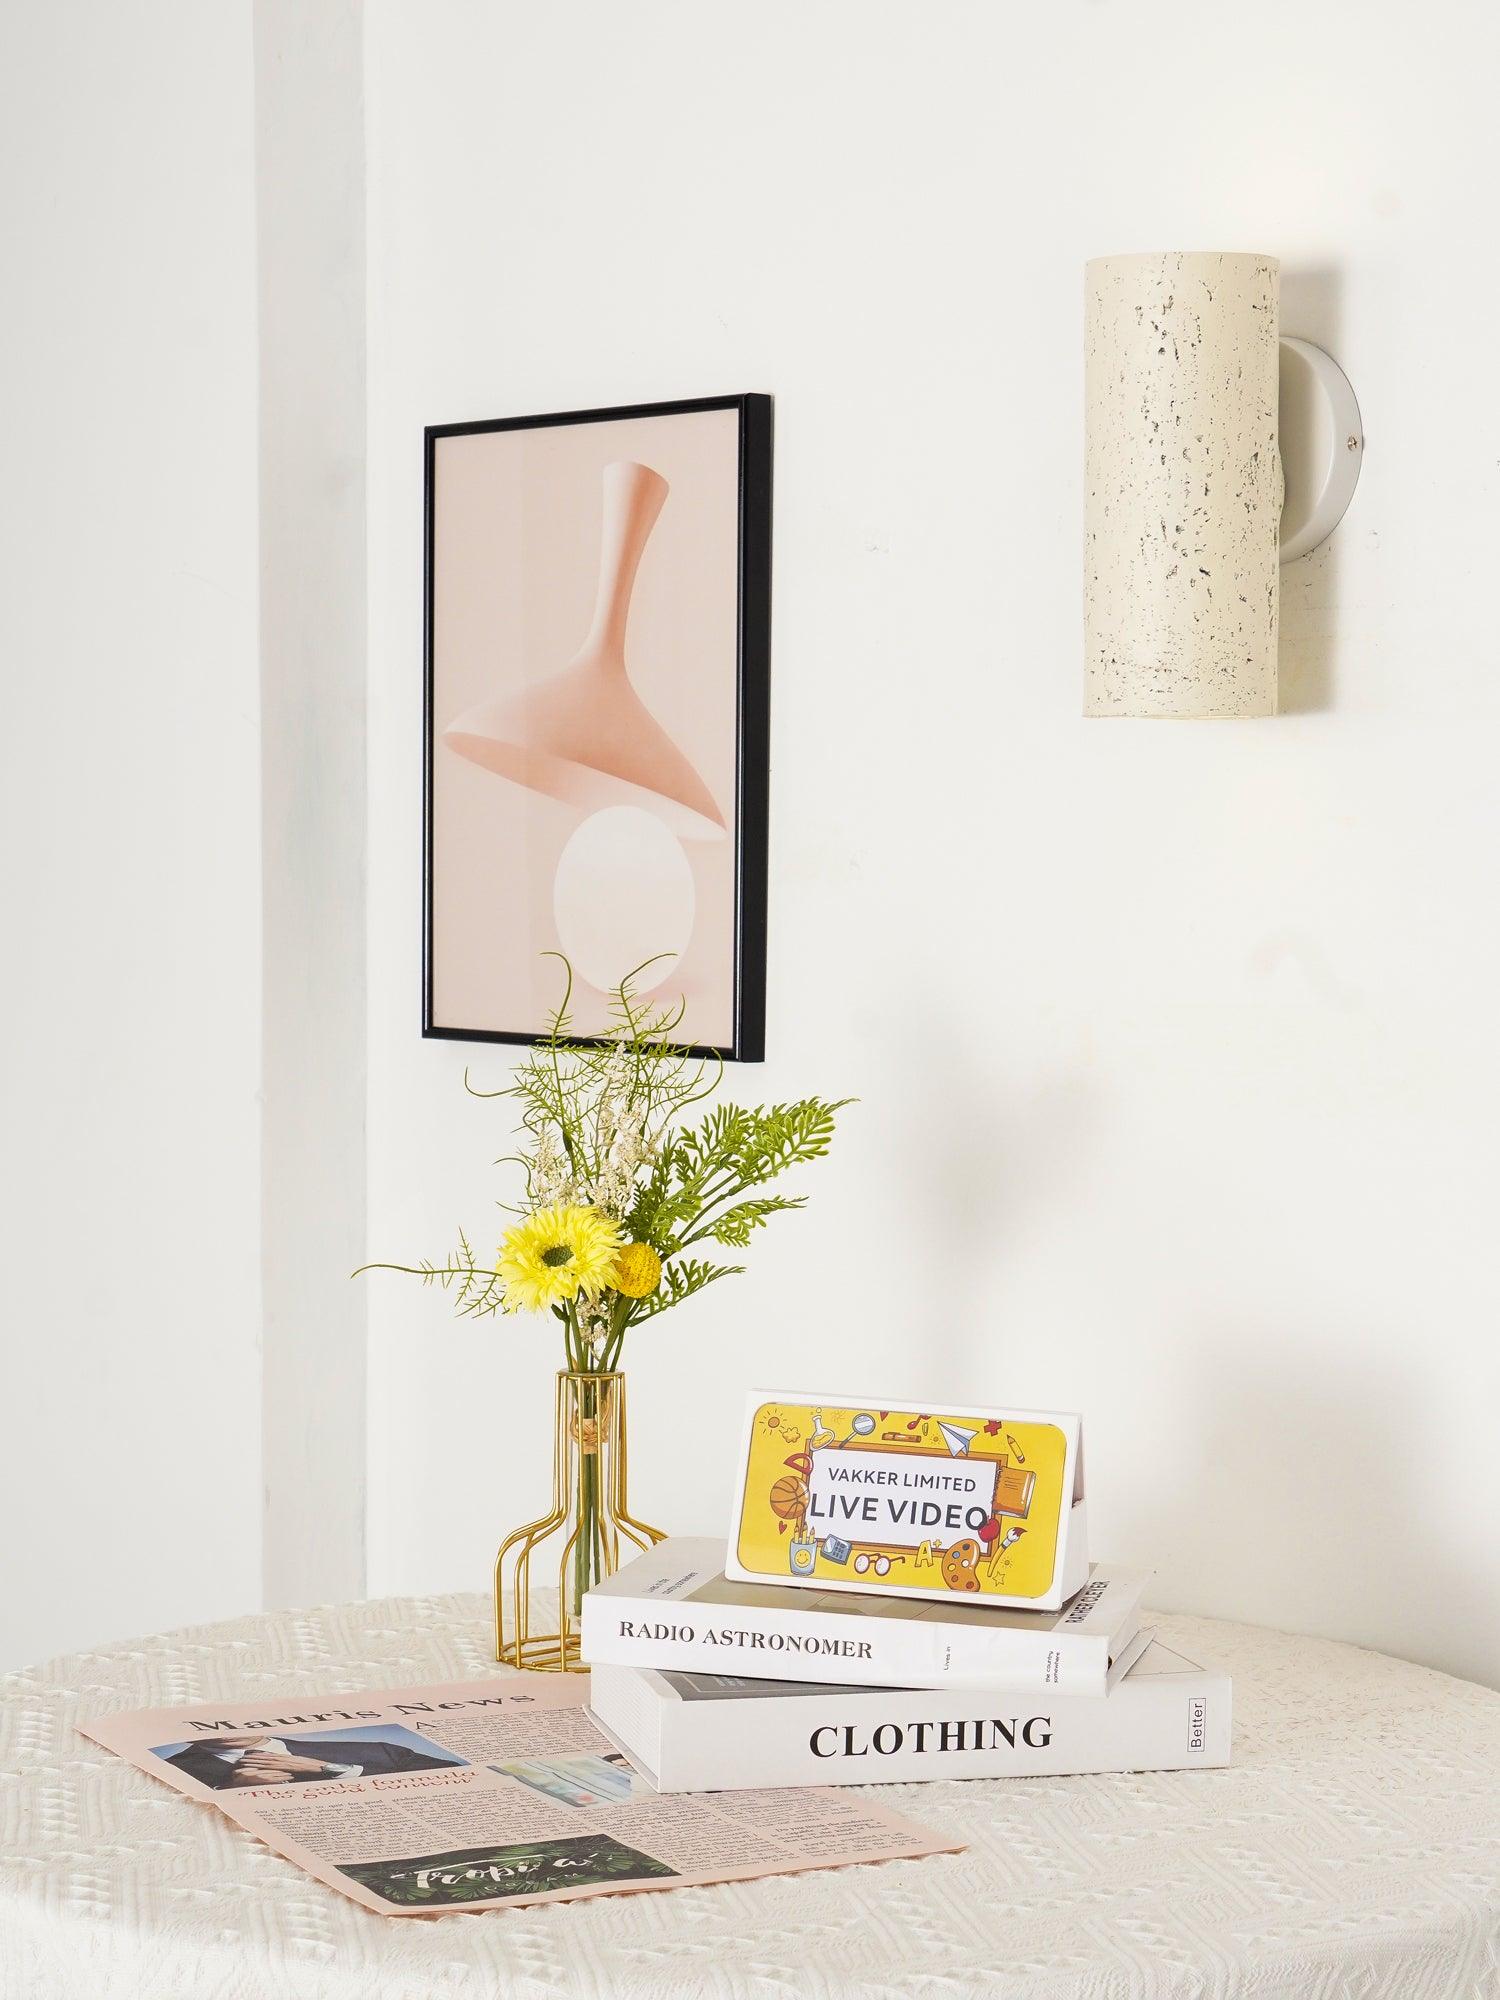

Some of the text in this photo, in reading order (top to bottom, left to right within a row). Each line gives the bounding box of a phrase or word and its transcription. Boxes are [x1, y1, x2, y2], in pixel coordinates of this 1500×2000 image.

[828, 1467, 976, 1492] VAKKER LIMITED
[810, 1493, 988, 1531] LIVE VIDEO
[619, 1620, 873, 1659] RADIO ASTRONOMER
[943, 1653, 951, 1671] Lives
[1046, 1650, 1054, 1673] country
[1053, 1651, 1061, 1683] somewhere
[184, 1695, 536, 1732] Mauris News
[1190, 1703, 1203, 1748] Better
[809, 1716, 1054, 1758] CLOTHING
[372, 1771, 479, 1786] formula
